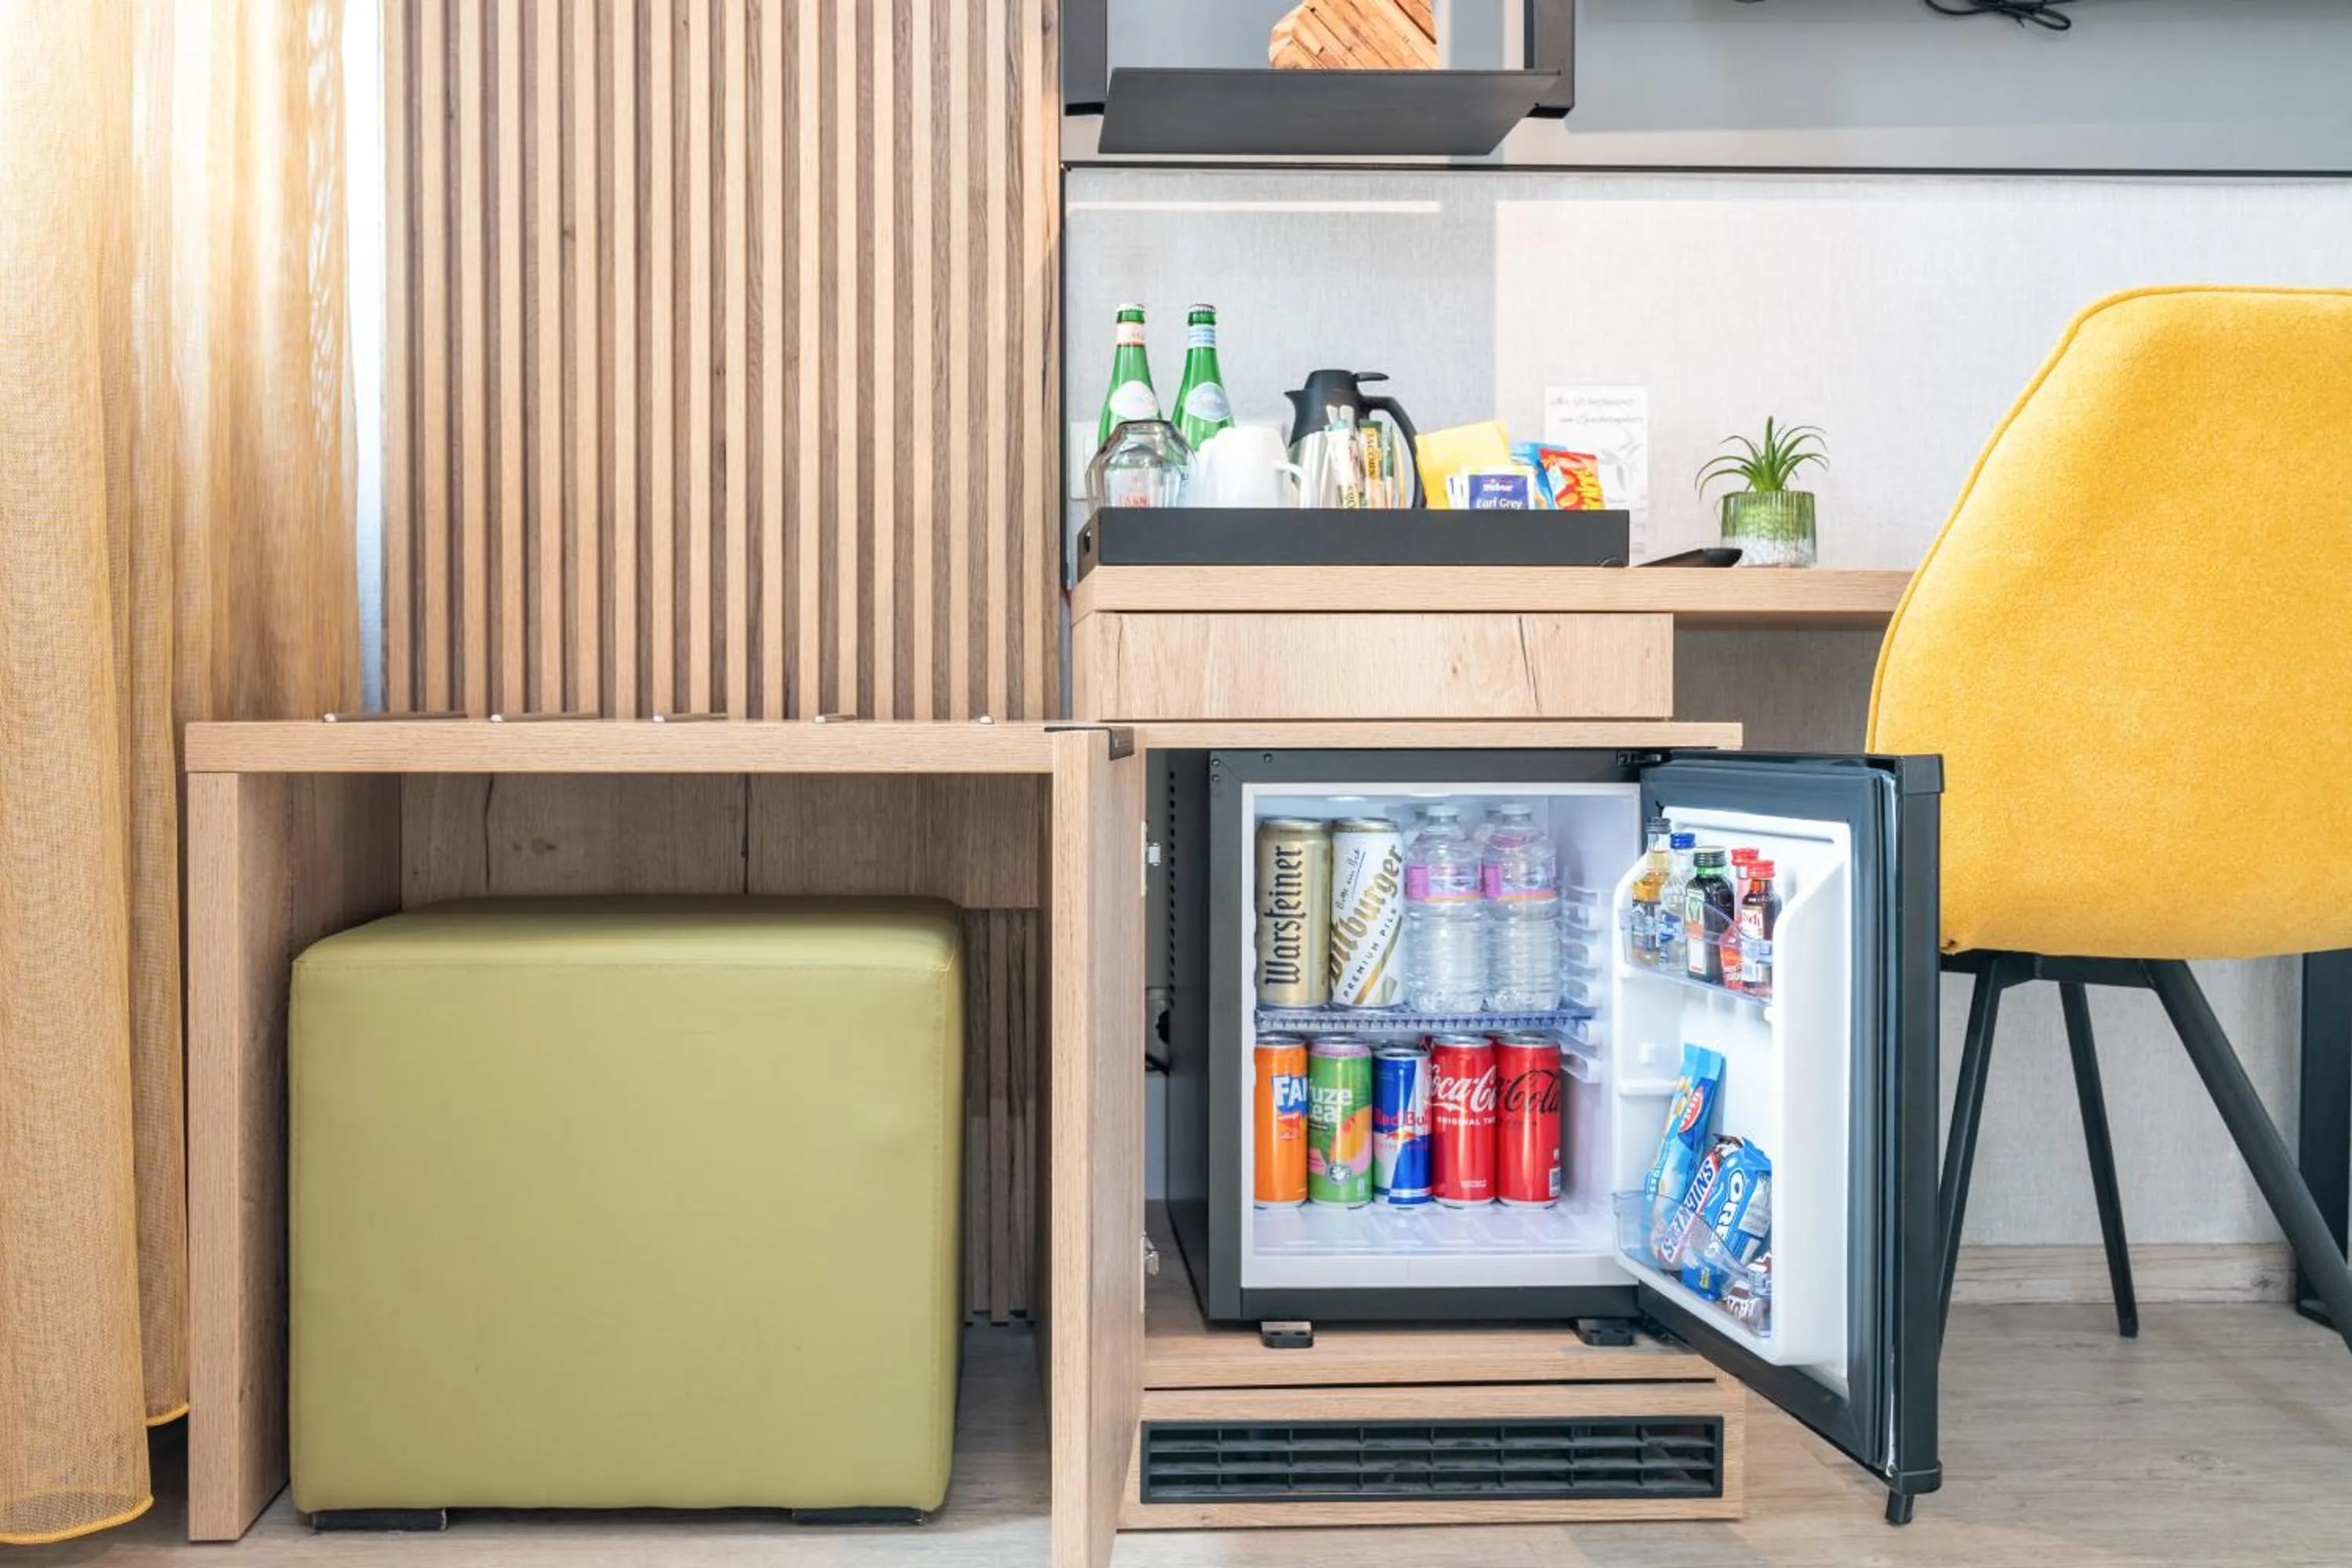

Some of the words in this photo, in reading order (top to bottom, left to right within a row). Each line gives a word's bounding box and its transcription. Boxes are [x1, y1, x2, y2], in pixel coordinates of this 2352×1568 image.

[1476, 496, 1498, 509] Earl
[1264, 845, 1306, 985] Warsteiner
[1343, 942, 1380, 997] PREMIUM
[1380, 908, 1397, 936] PILS
[1310, 1084, 1353, 1106] uze
